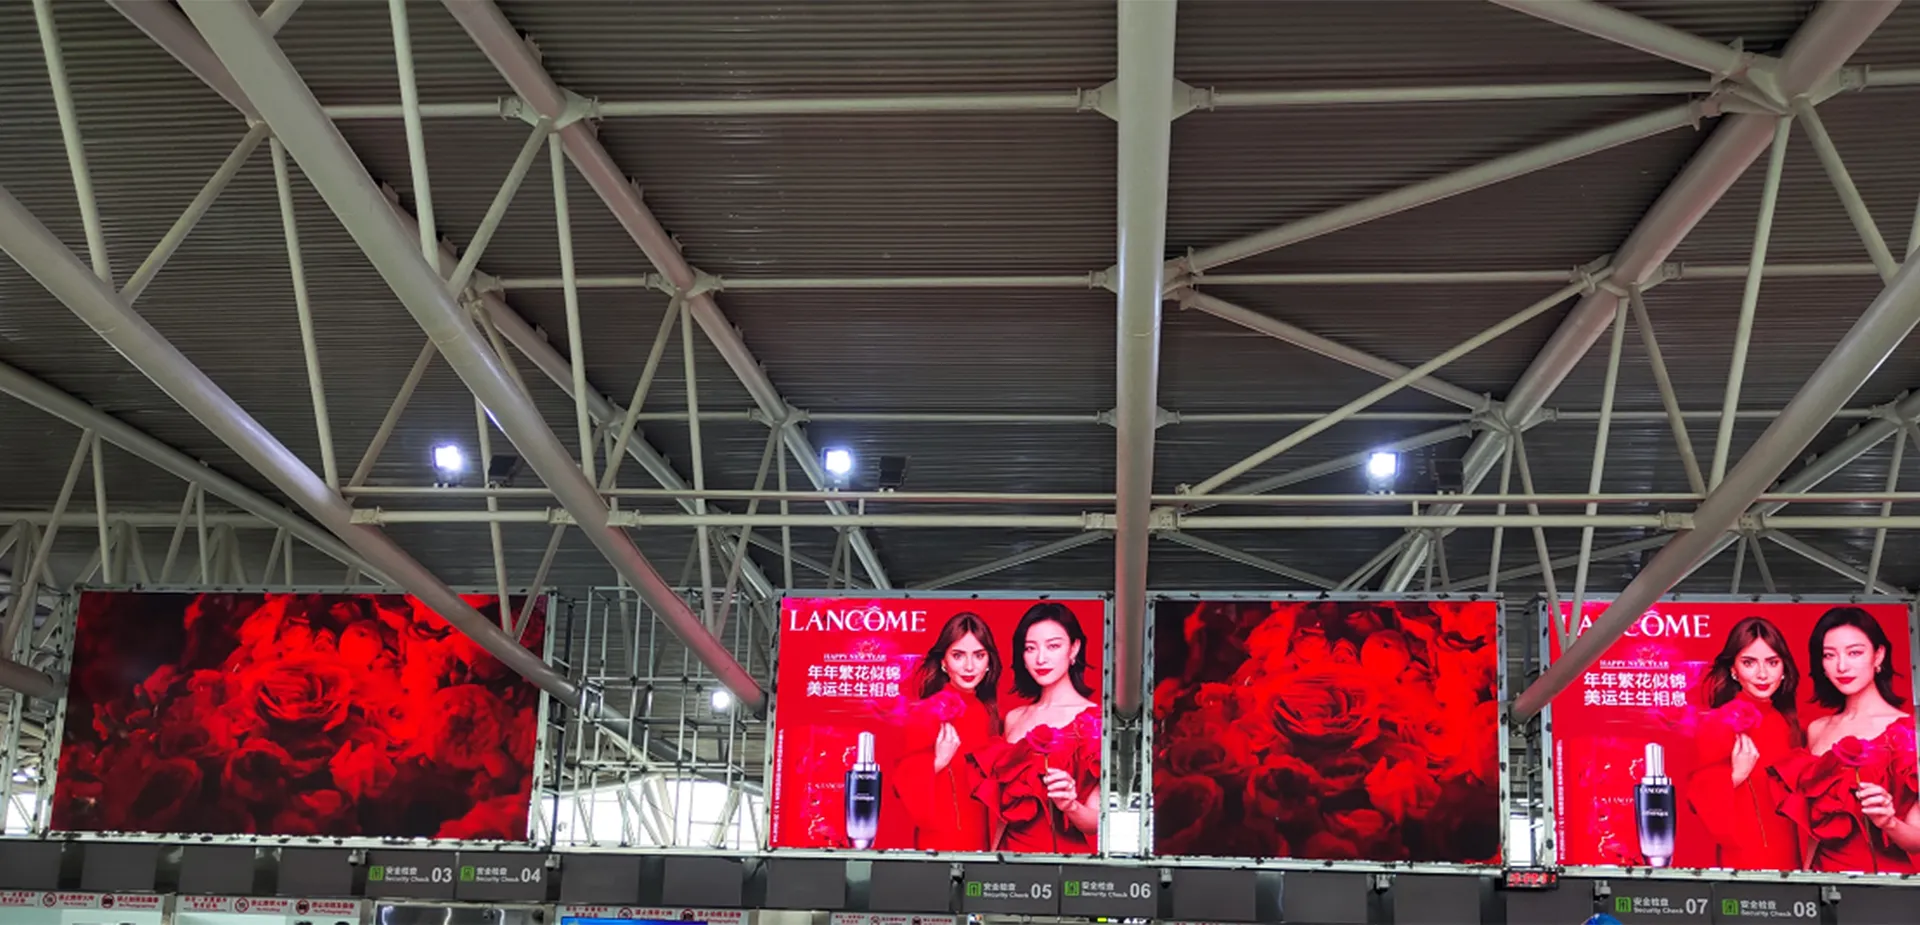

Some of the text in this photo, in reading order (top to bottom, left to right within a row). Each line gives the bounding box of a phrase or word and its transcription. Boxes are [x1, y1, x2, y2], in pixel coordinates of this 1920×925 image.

[789, 606, 927, 632] LANCÔME
[808, 665, 900, 680] 年年繁花似锦
[1584, 673, 1687, 689] 年年繁花似锦
[807, 681, 899, 697] 美运生生相息
[1584, 690, 1687, 707] 美运生生相息
[431, 867, 452, 883] 03
[521, 868, 541, 883] 04
[1031, 884, 1052, 899] 05
[1129, 883, 1151, 898] 06
[1685, 899, 1708, 914] 07
[1793, 902, 1817, 917] 08
